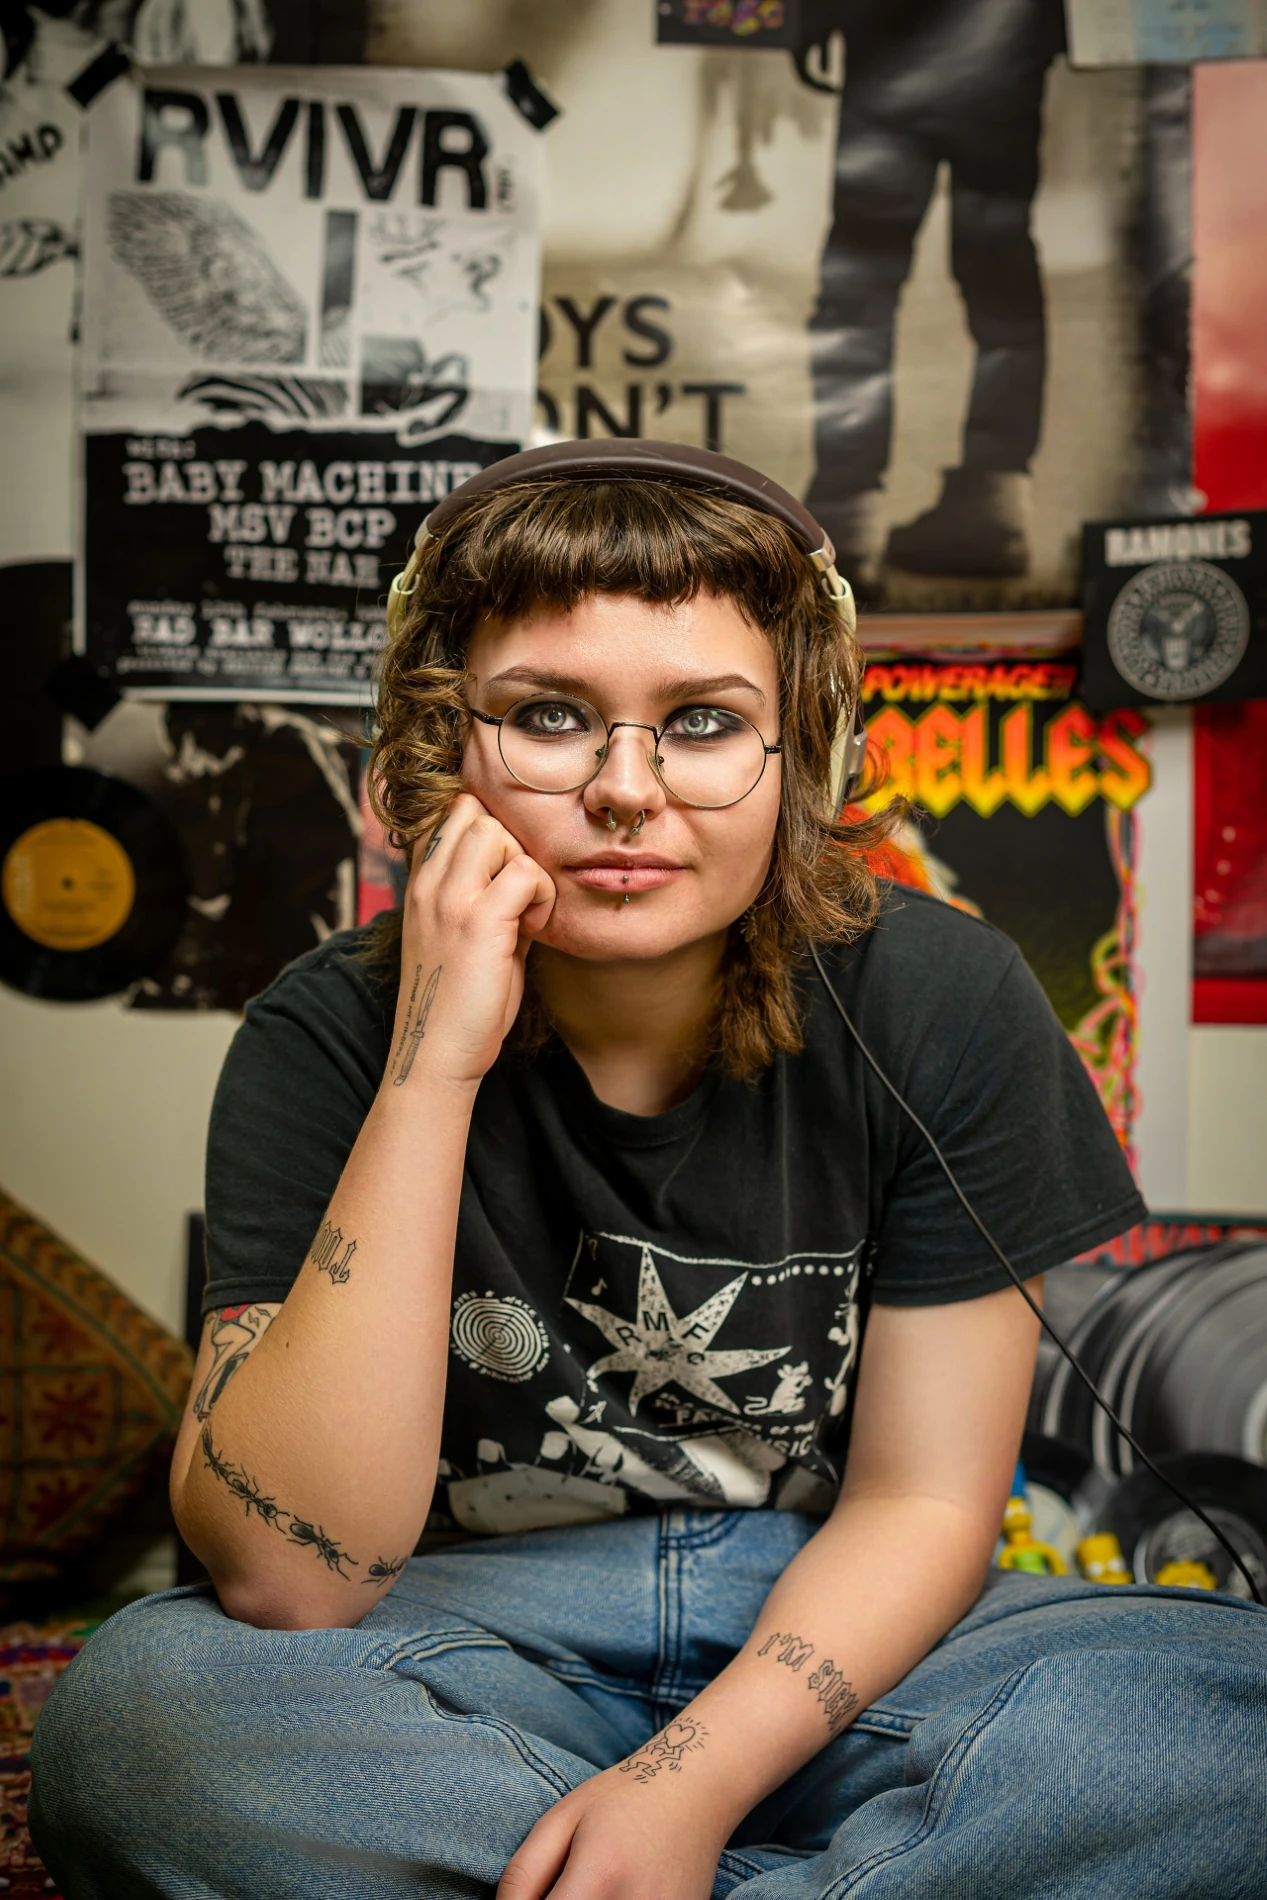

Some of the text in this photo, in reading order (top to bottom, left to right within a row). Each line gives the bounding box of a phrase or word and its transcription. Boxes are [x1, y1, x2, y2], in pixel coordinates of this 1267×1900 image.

[137, 89, 488, 209] RVIVR
[121, 460, 248, 504] BABY
[207, 503, 397, 549] MSV BCP
[1105, 519, 1251, 567] RAMONES
[223, 544, 299, 582] THE
[757, 1631, 859, 1732] I'M SICK
